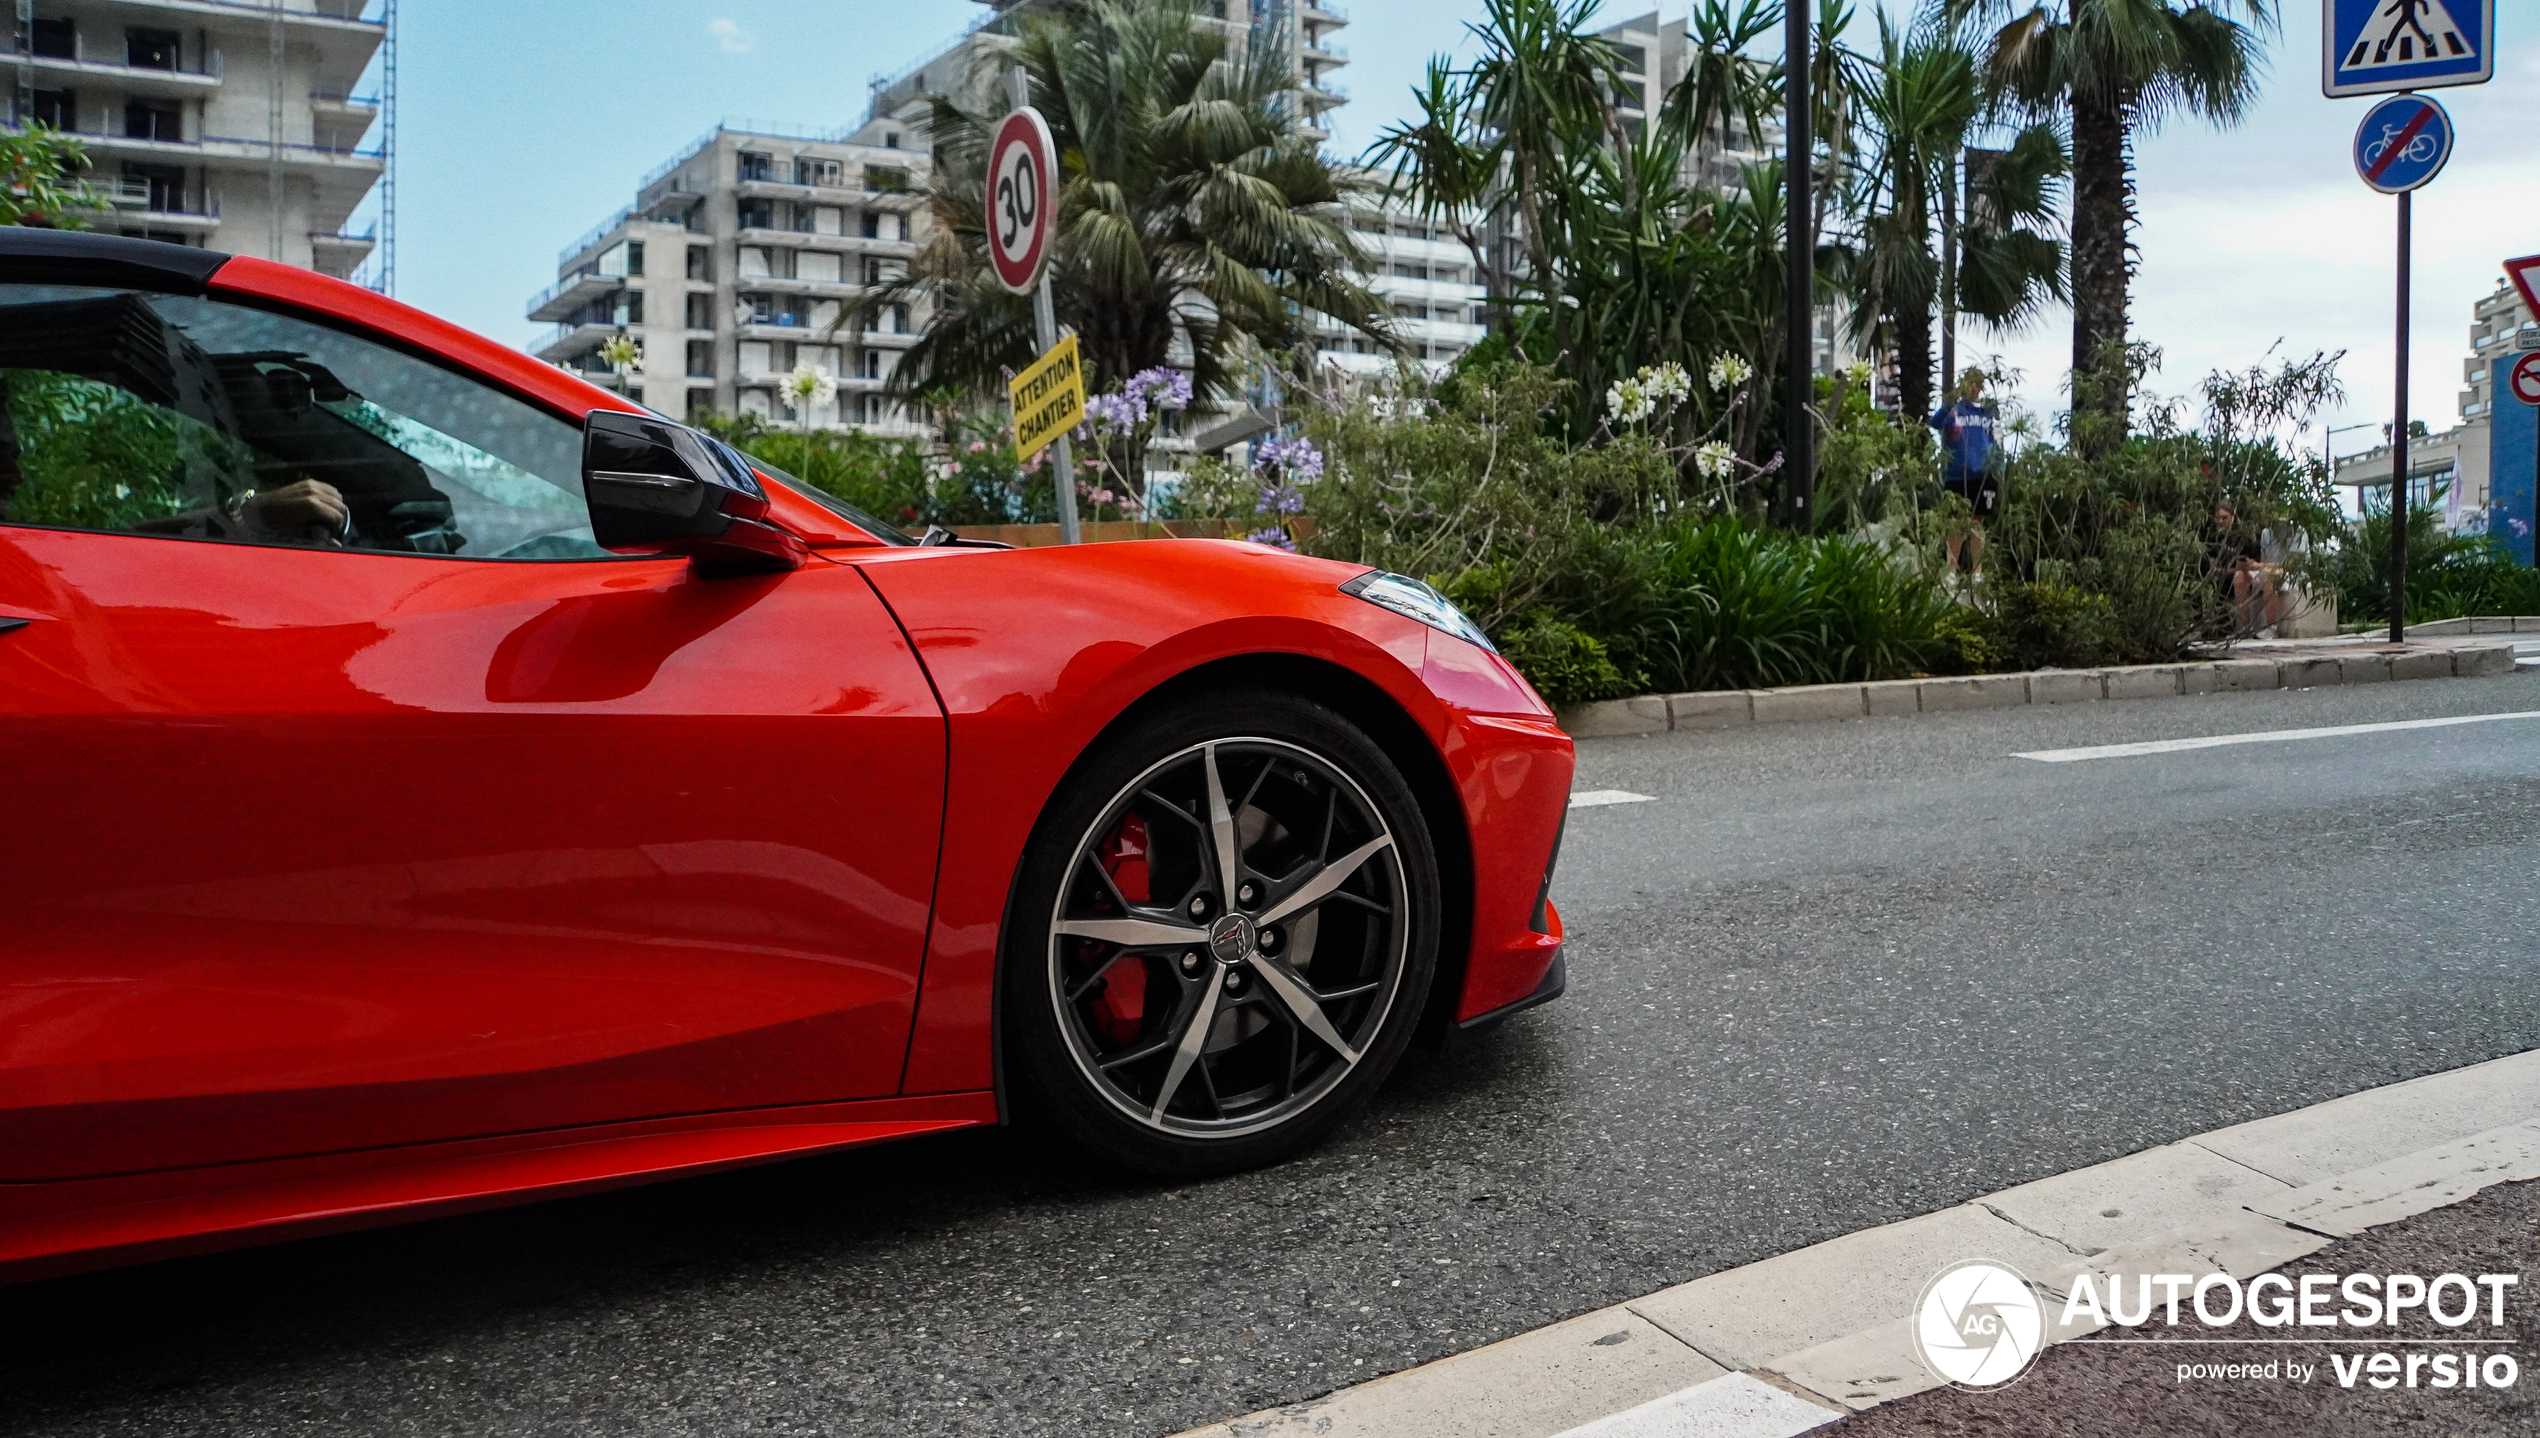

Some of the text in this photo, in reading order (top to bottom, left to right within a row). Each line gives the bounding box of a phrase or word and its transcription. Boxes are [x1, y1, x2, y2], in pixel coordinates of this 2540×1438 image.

[998, 153, 1035, 249] 30
[1014, 349, 1075, 415] ATTENTION
[1019, 387, 1077, 446] CHANTIER
